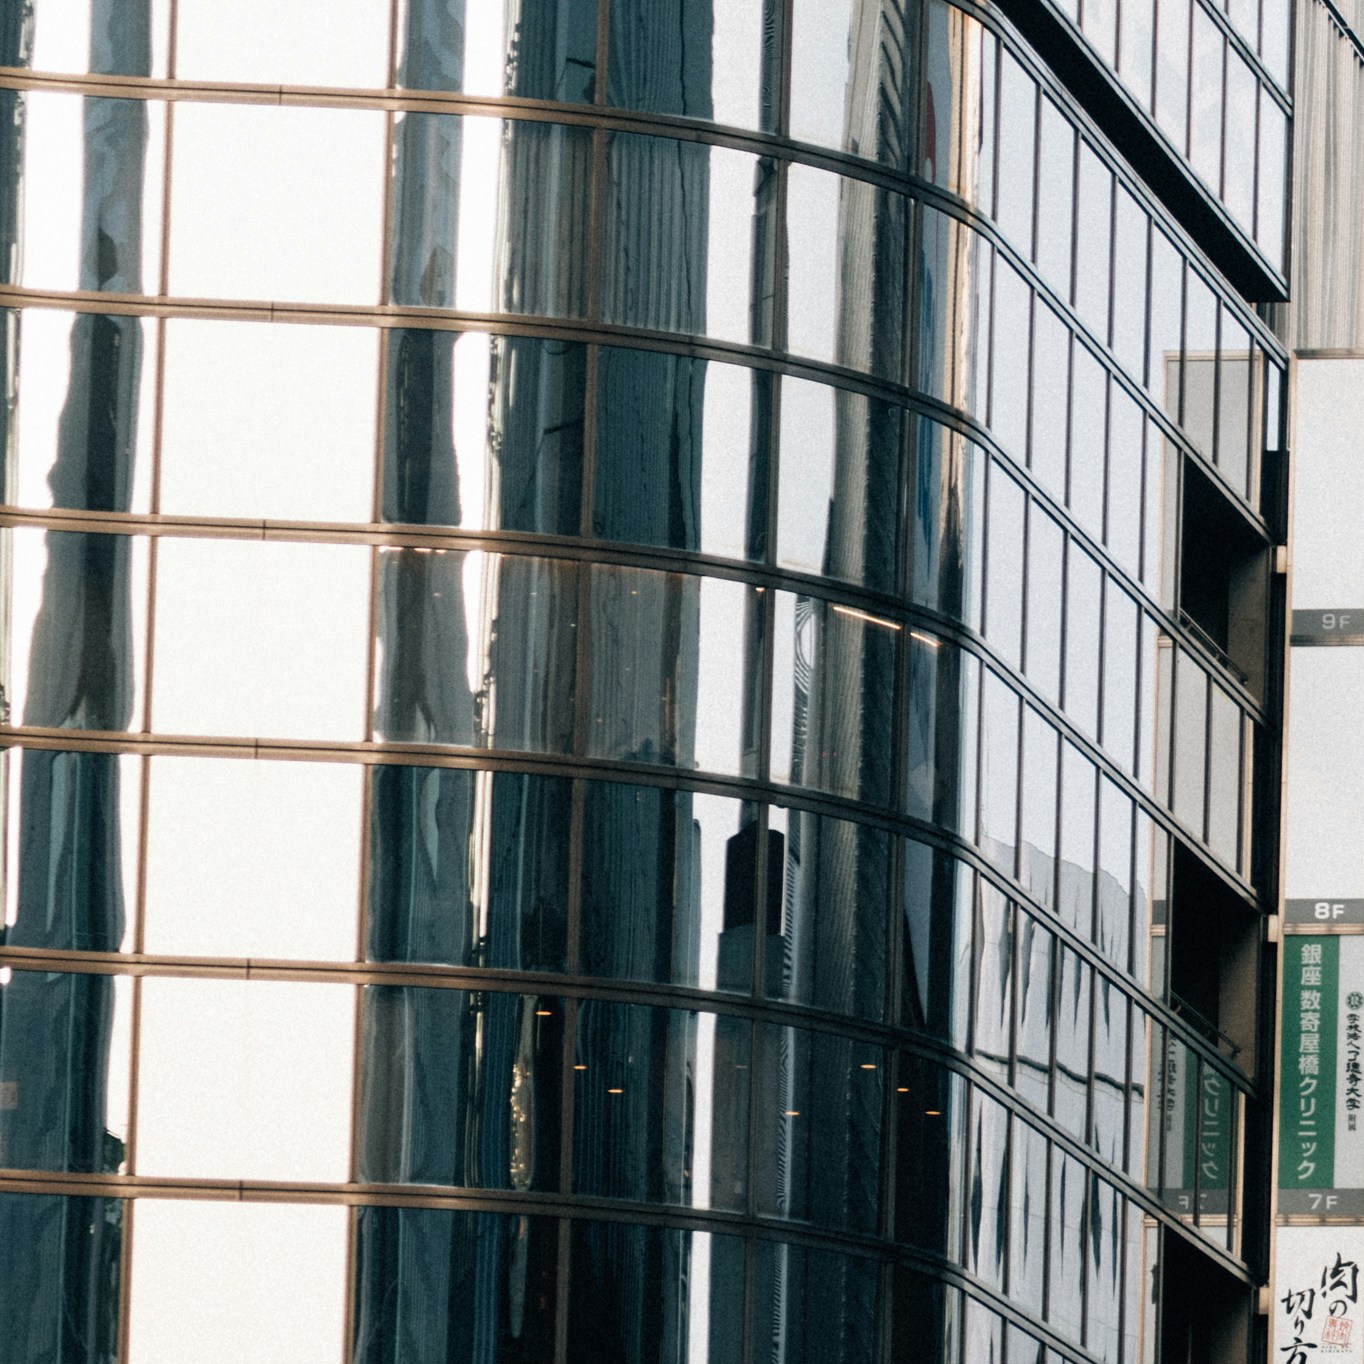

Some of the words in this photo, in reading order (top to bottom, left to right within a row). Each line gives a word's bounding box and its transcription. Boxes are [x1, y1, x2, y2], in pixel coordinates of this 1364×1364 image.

[1321, 613, 1350, 629] 9F
[1314, 903, 1345, 919] 8F
[1297, 944, 1322, 1180] 銀座数寄屋橋クリニック
[1308, 1194, 1338, 1210] 7F
[1320, 1252, 1360, 1317] 肉の
